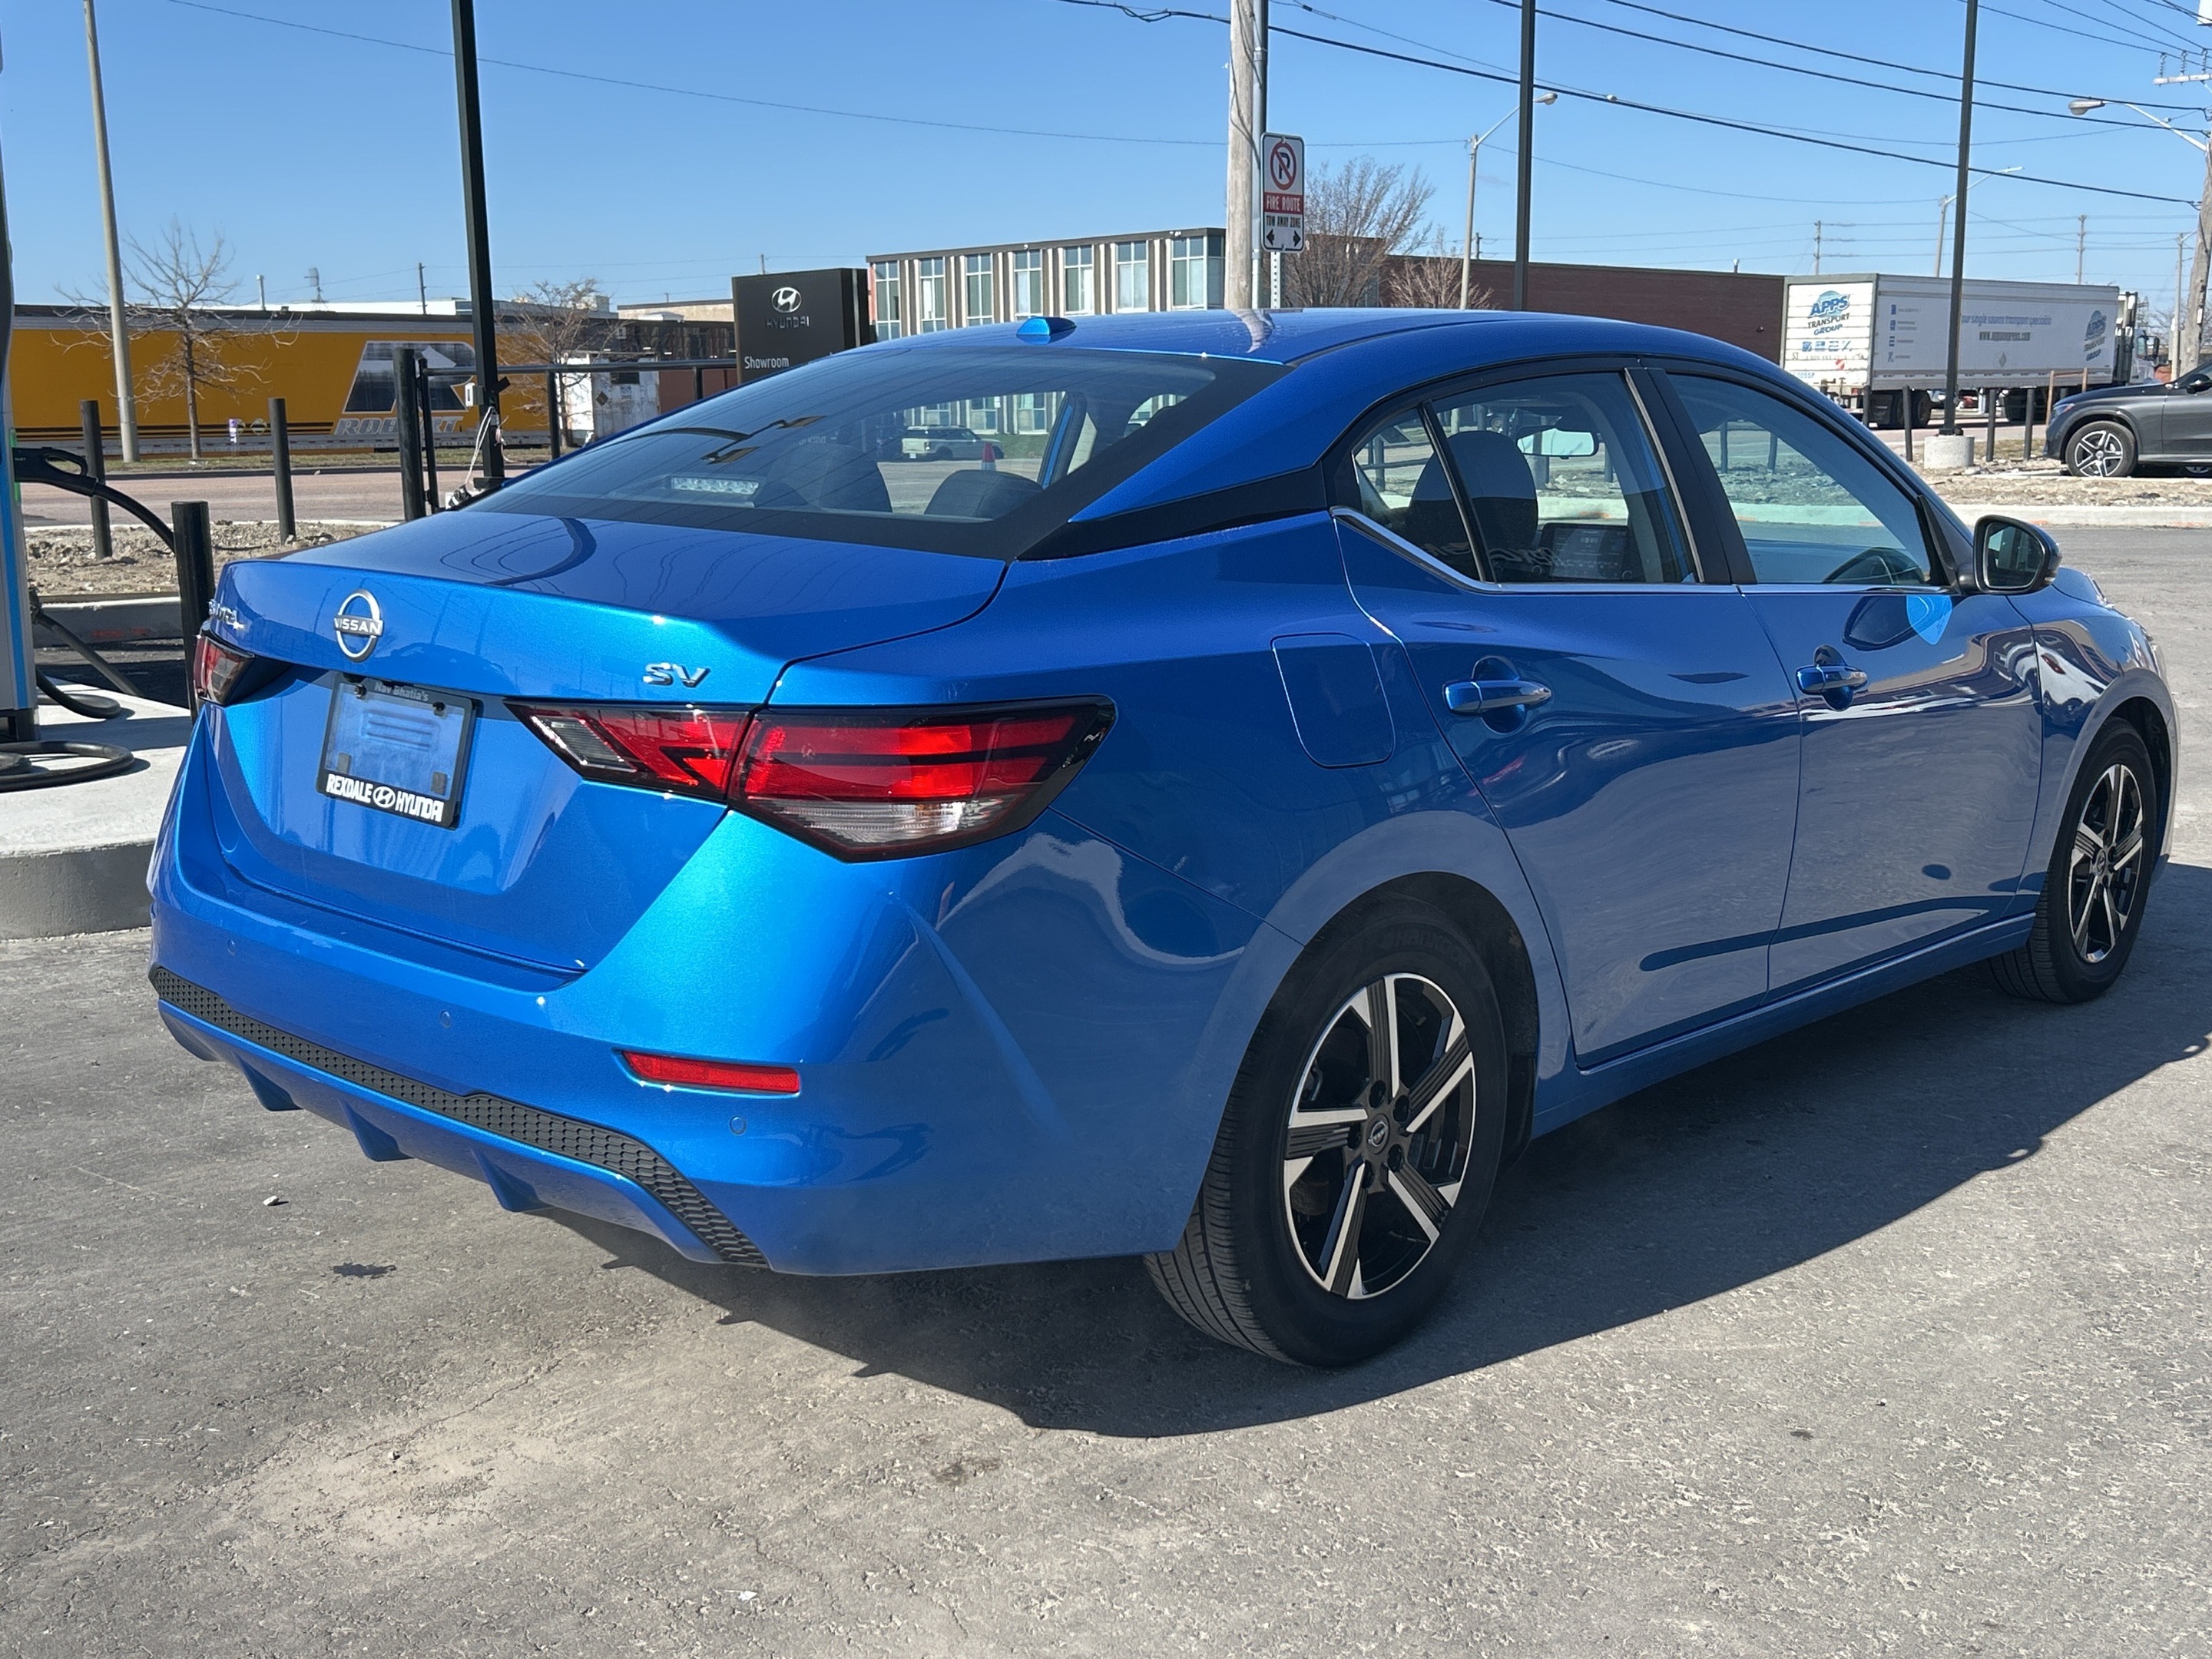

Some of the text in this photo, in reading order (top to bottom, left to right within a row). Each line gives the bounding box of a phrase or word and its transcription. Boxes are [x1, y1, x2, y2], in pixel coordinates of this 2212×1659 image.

[1266, 195, 1301, 212] FIRE ROUTE
[1266, 215, 1301, 228] TOW AWAY ZONE
[1808, 295, 1849, 318] APPS
[766, 316, 811, 329] HYUNDAI
[1807, 313, 1850, 329] TRANSPORT
[1813, 323, 1843, 336] GROUP
[744, 356, 790, 369] Showroom
[334, 416, 464, 435] ROBRT
[334, 618, 381, 635] NISSAN
[643, 662, 711, 688] SV
[374, 681, 429, 702] Nav Bhatia's
[326, 773, 445, 822] REXDALE HYUNDAI
